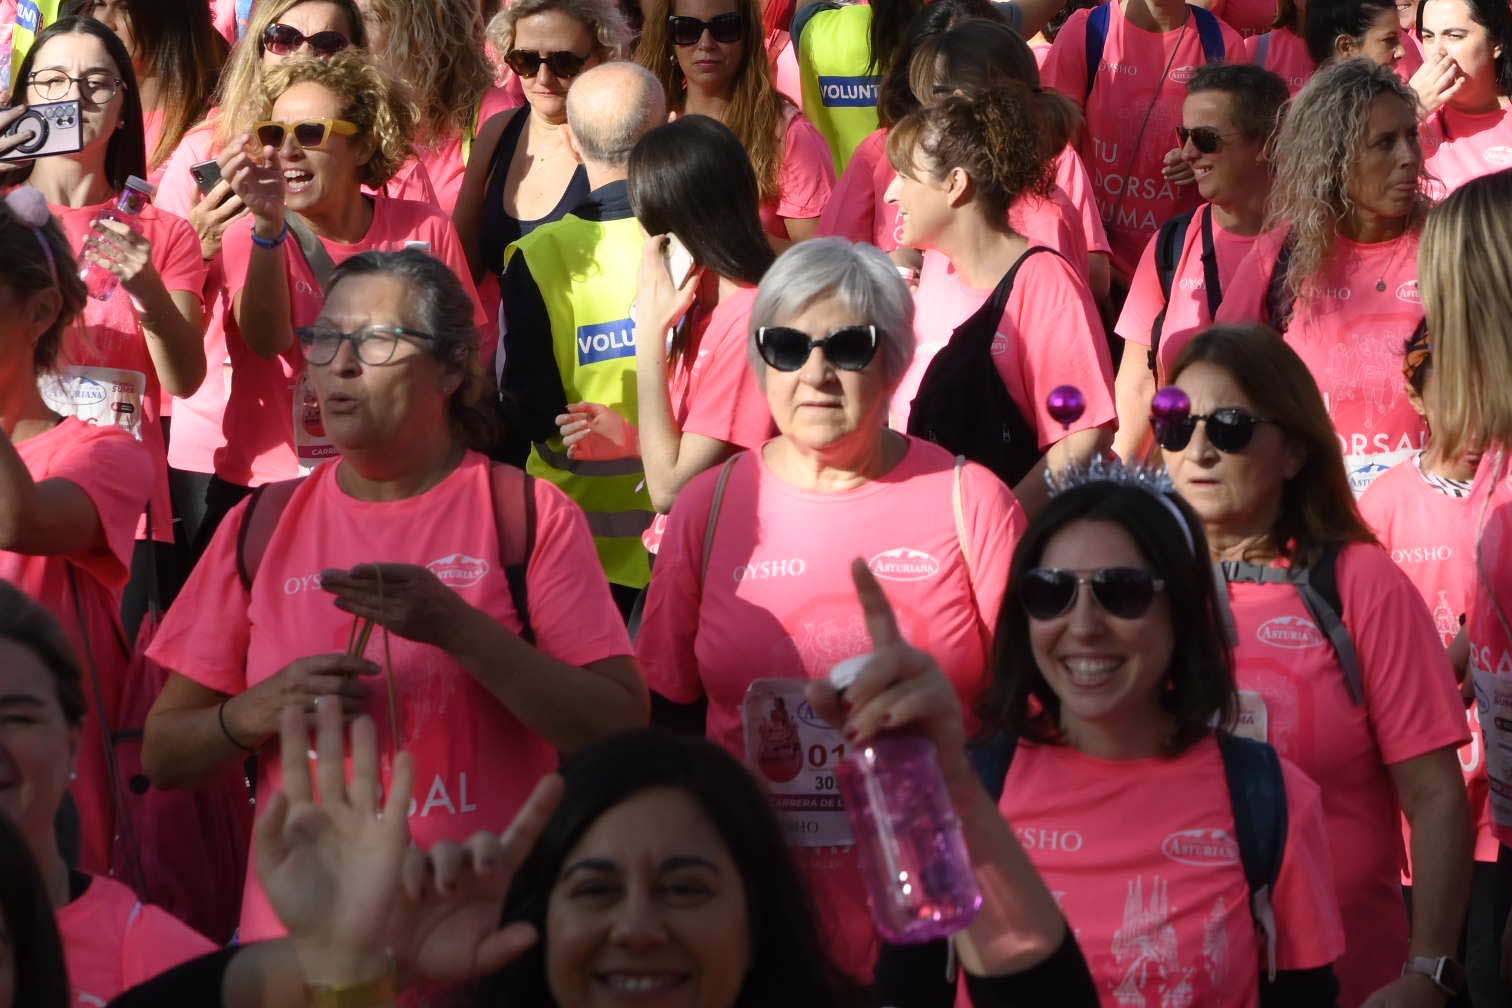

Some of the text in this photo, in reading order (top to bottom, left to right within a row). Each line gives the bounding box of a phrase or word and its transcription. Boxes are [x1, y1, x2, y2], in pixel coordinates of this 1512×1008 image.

[1094, 138, 1118, 163] TU
[1391, 544, 1452, 562] OYSHO
[733, 558, 806, 583] OYSHO
[814, 775, 840, 790] 30
